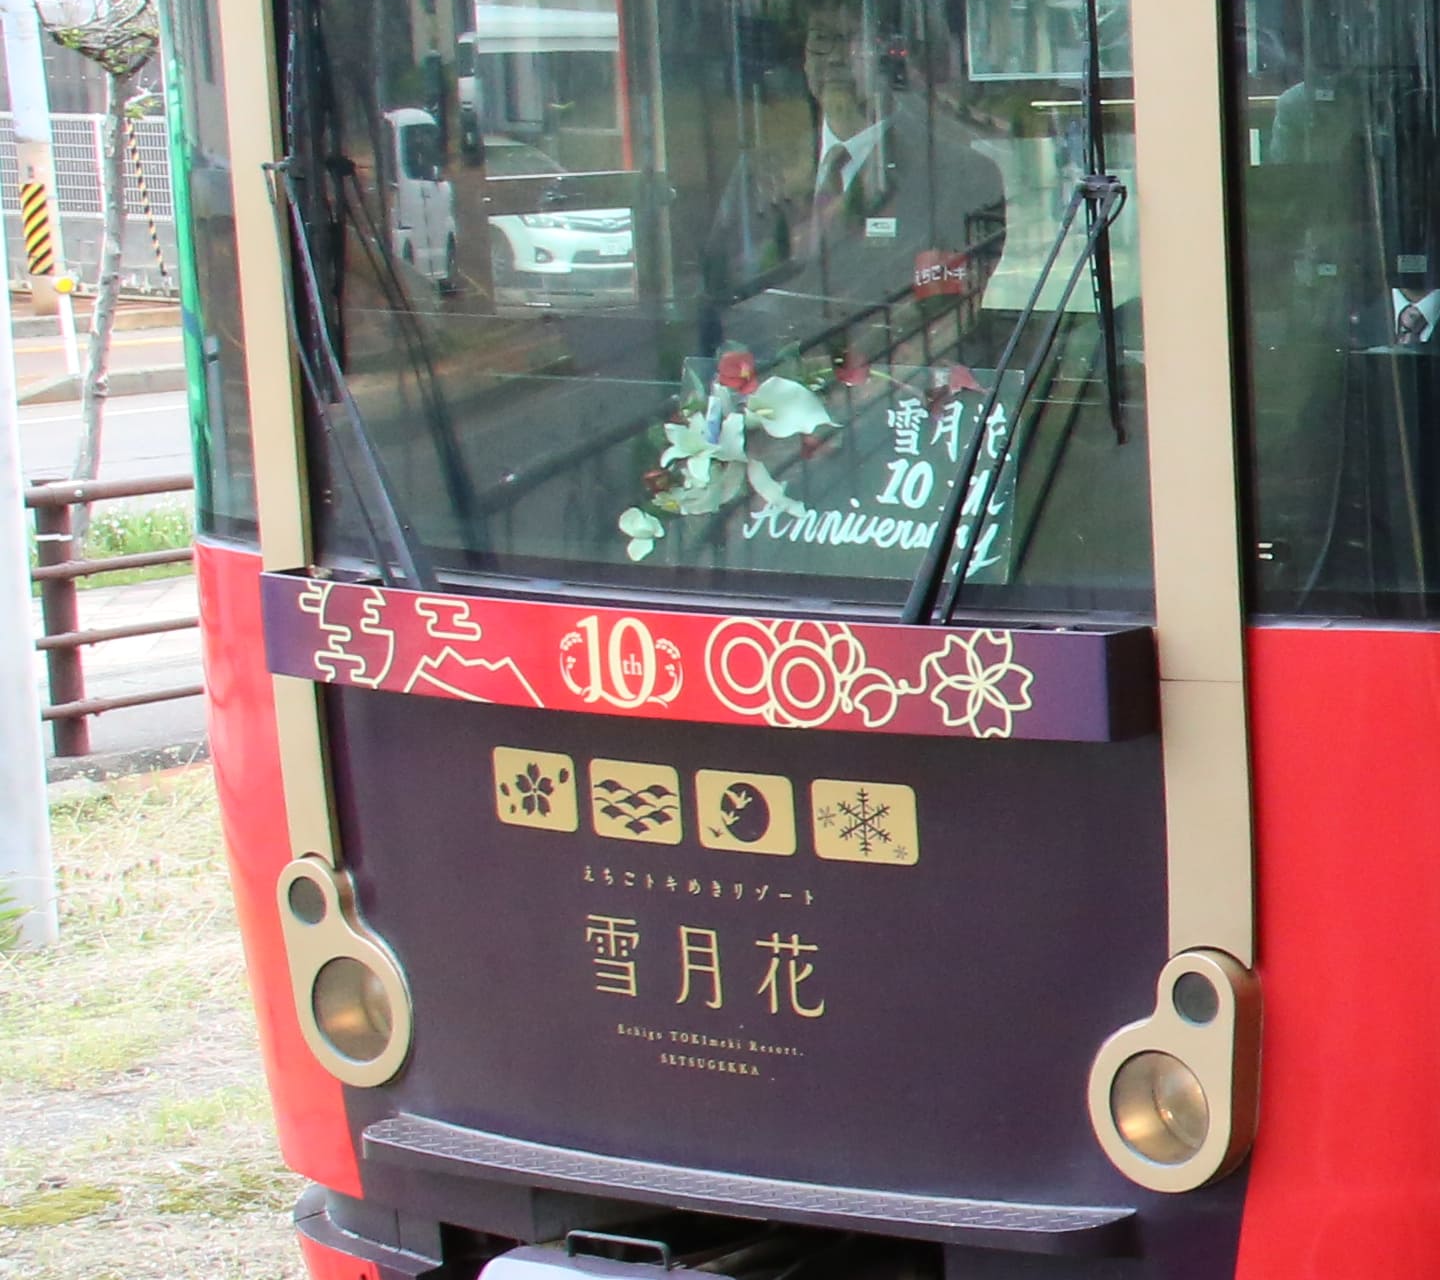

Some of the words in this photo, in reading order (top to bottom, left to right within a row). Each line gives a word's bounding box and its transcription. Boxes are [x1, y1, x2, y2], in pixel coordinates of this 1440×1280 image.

[583, 865, 814, 905] えちごトキめきリゾート
[586, 914, 825, 1017] 雪月花
[617, 1023, 663, 1041] Echigo
[660, 1053, 760, 1076] SETSUGEKKA
